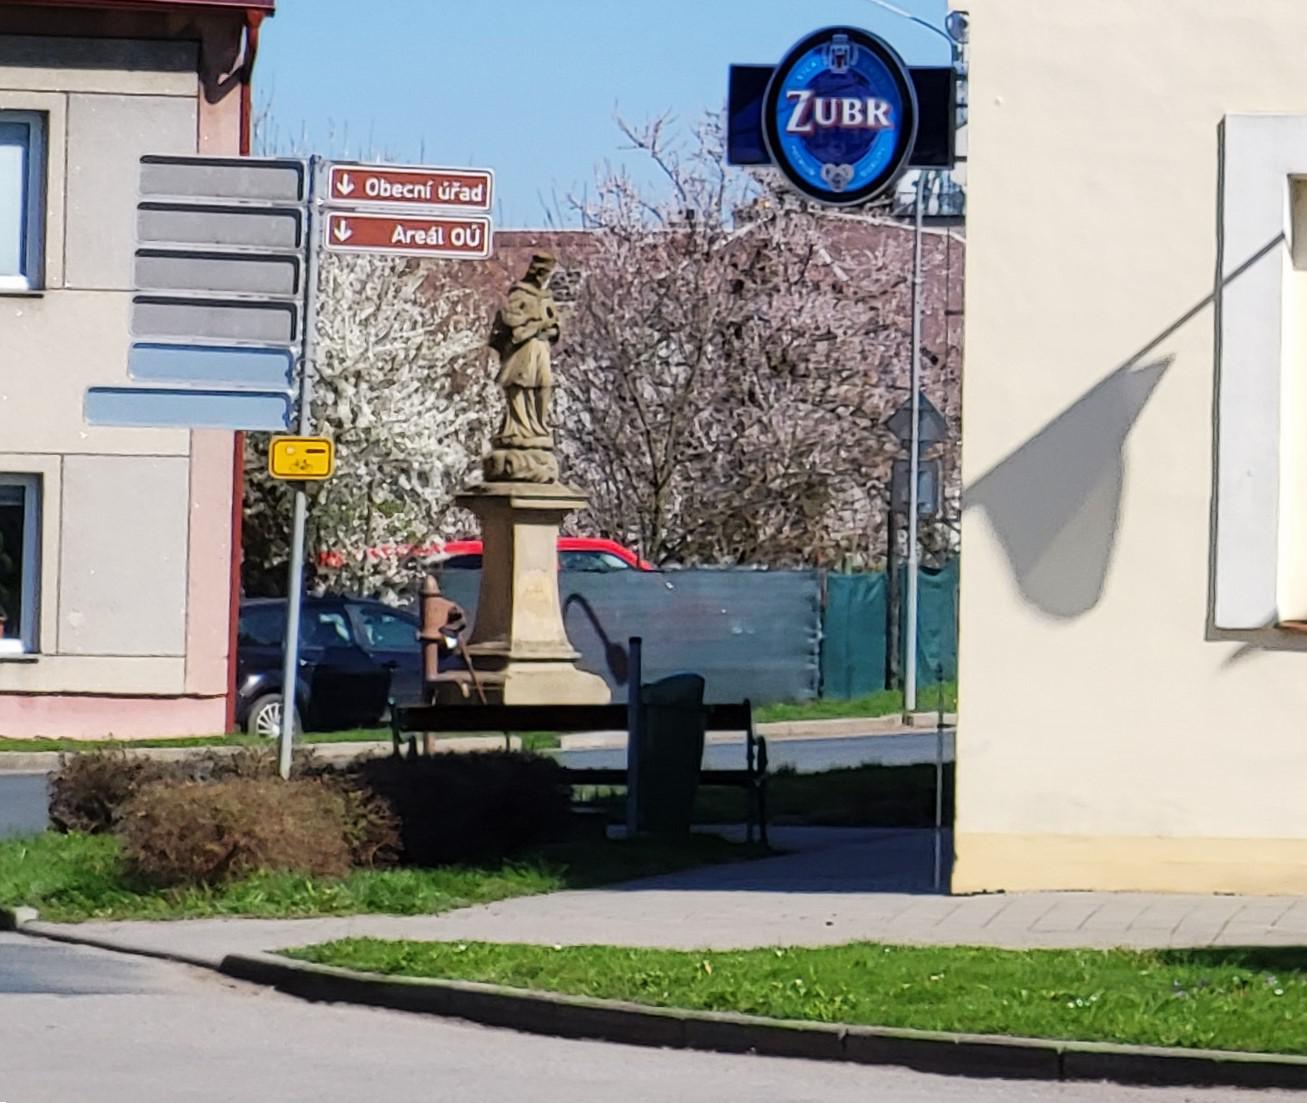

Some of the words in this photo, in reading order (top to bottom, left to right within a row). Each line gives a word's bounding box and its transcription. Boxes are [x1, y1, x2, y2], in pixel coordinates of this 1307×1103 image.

[364, 177, 432, 199] Obecní
[438, 180, 483, 202] úřad
[391, 224, 444, 245] Areál
[450, 224, 481, 247] OÚ
